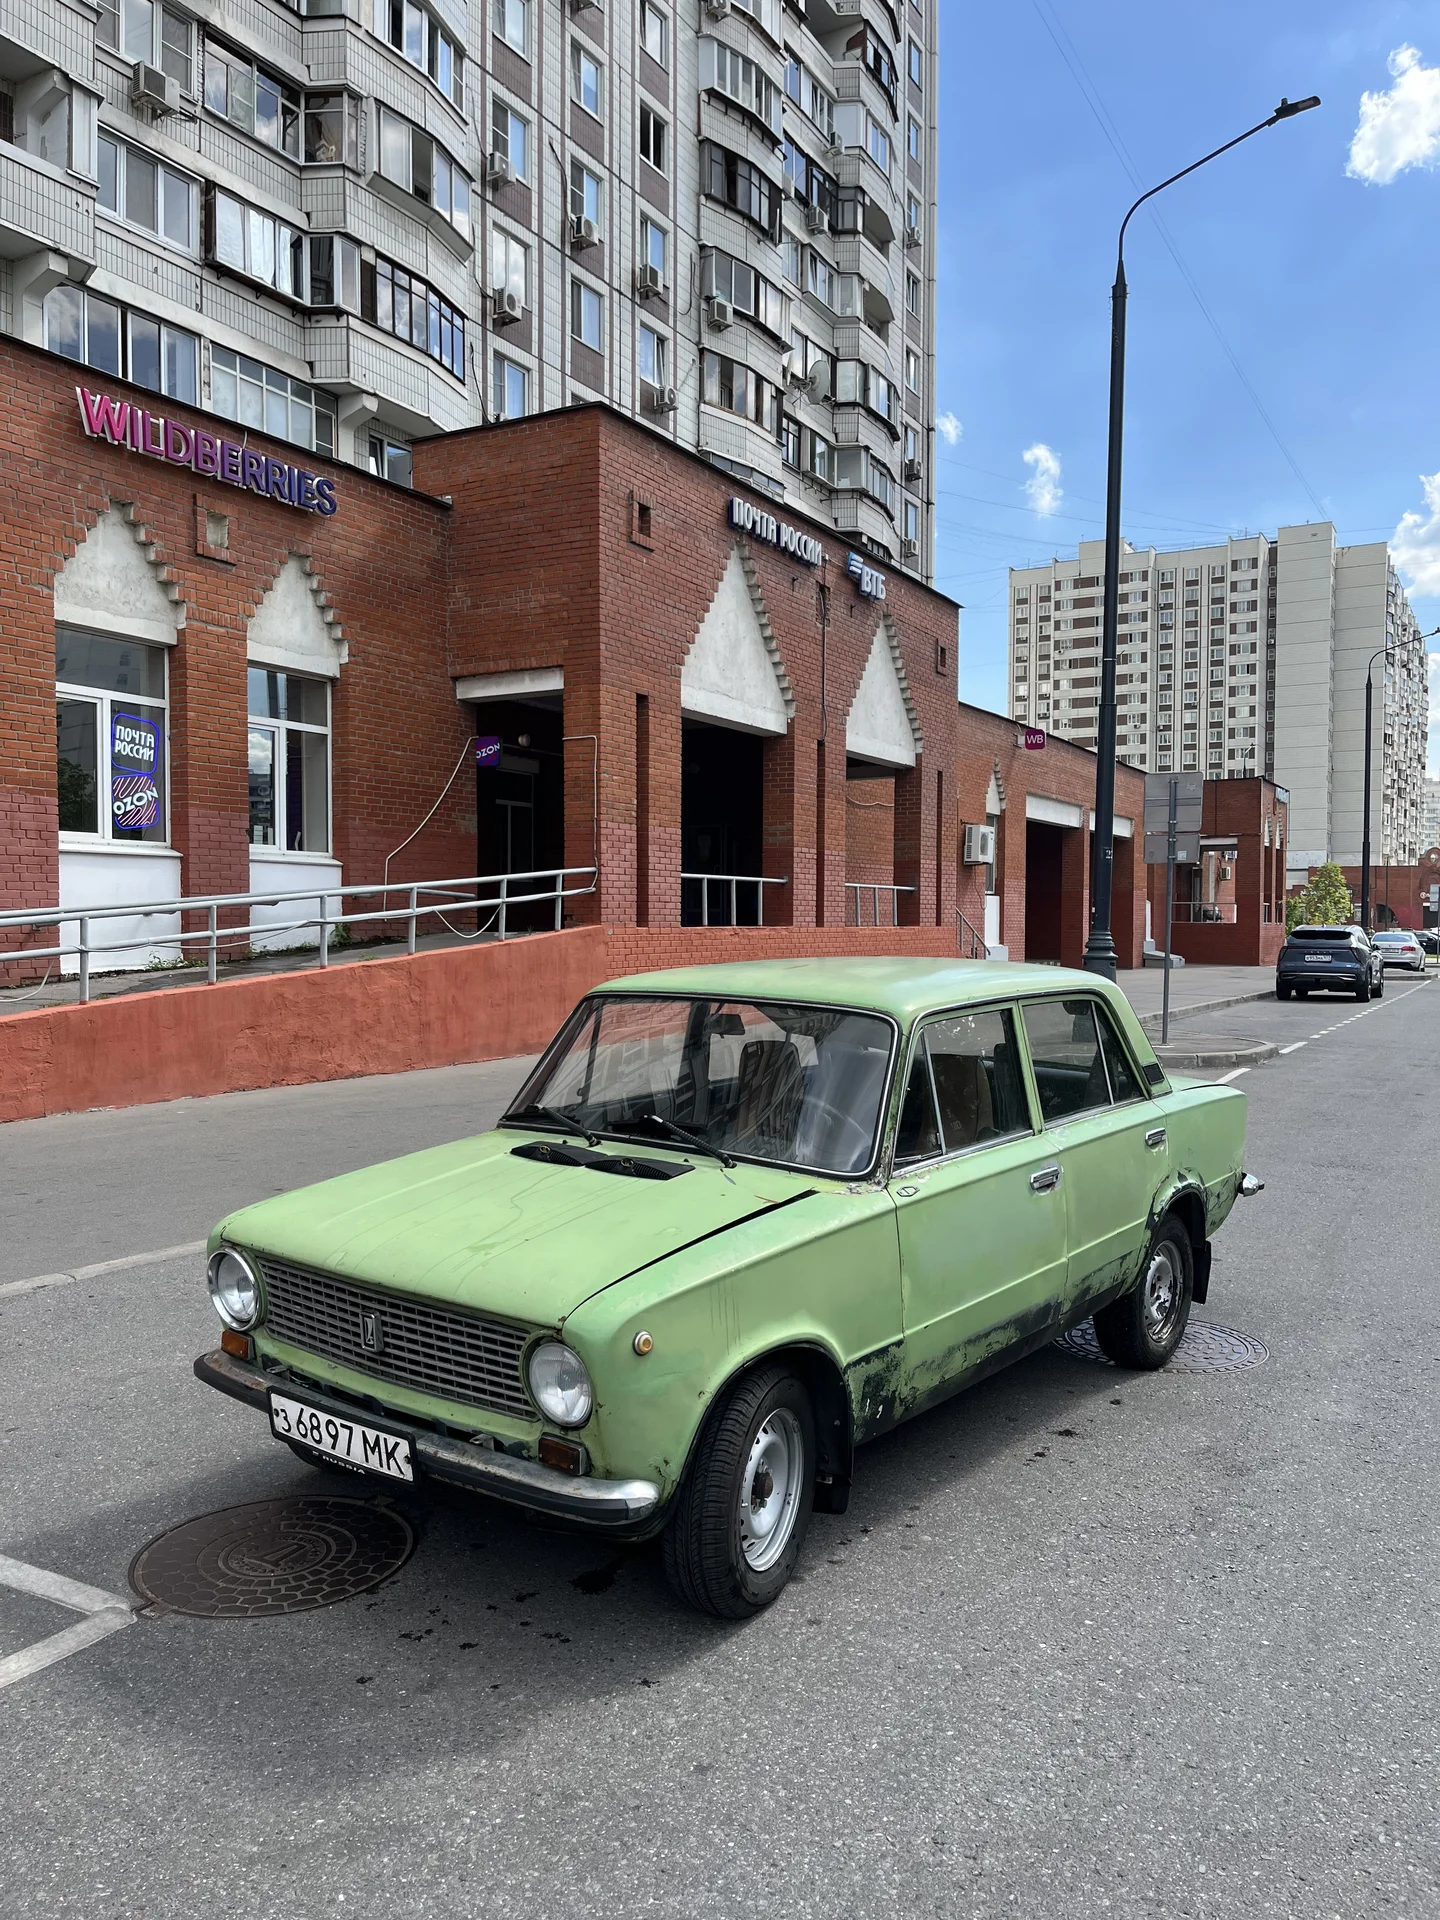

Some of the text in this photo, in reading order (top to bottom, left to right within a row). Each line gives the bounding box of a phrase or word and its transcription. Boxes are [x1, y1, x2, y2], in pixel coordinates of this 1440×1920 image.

[76, 387, 337, 516] WILDBERRIES
[732, 496, 822, 566] ПОЧТА РОССИИ
[861, 565, 887, 600] ВТБ
[115, 725, 155, 747] ПОЧТА
[1026, 734, 1044, 744] WB
[114, 739, 155, 762] РОССИИ
[113, 787, 159, 815] OZON
